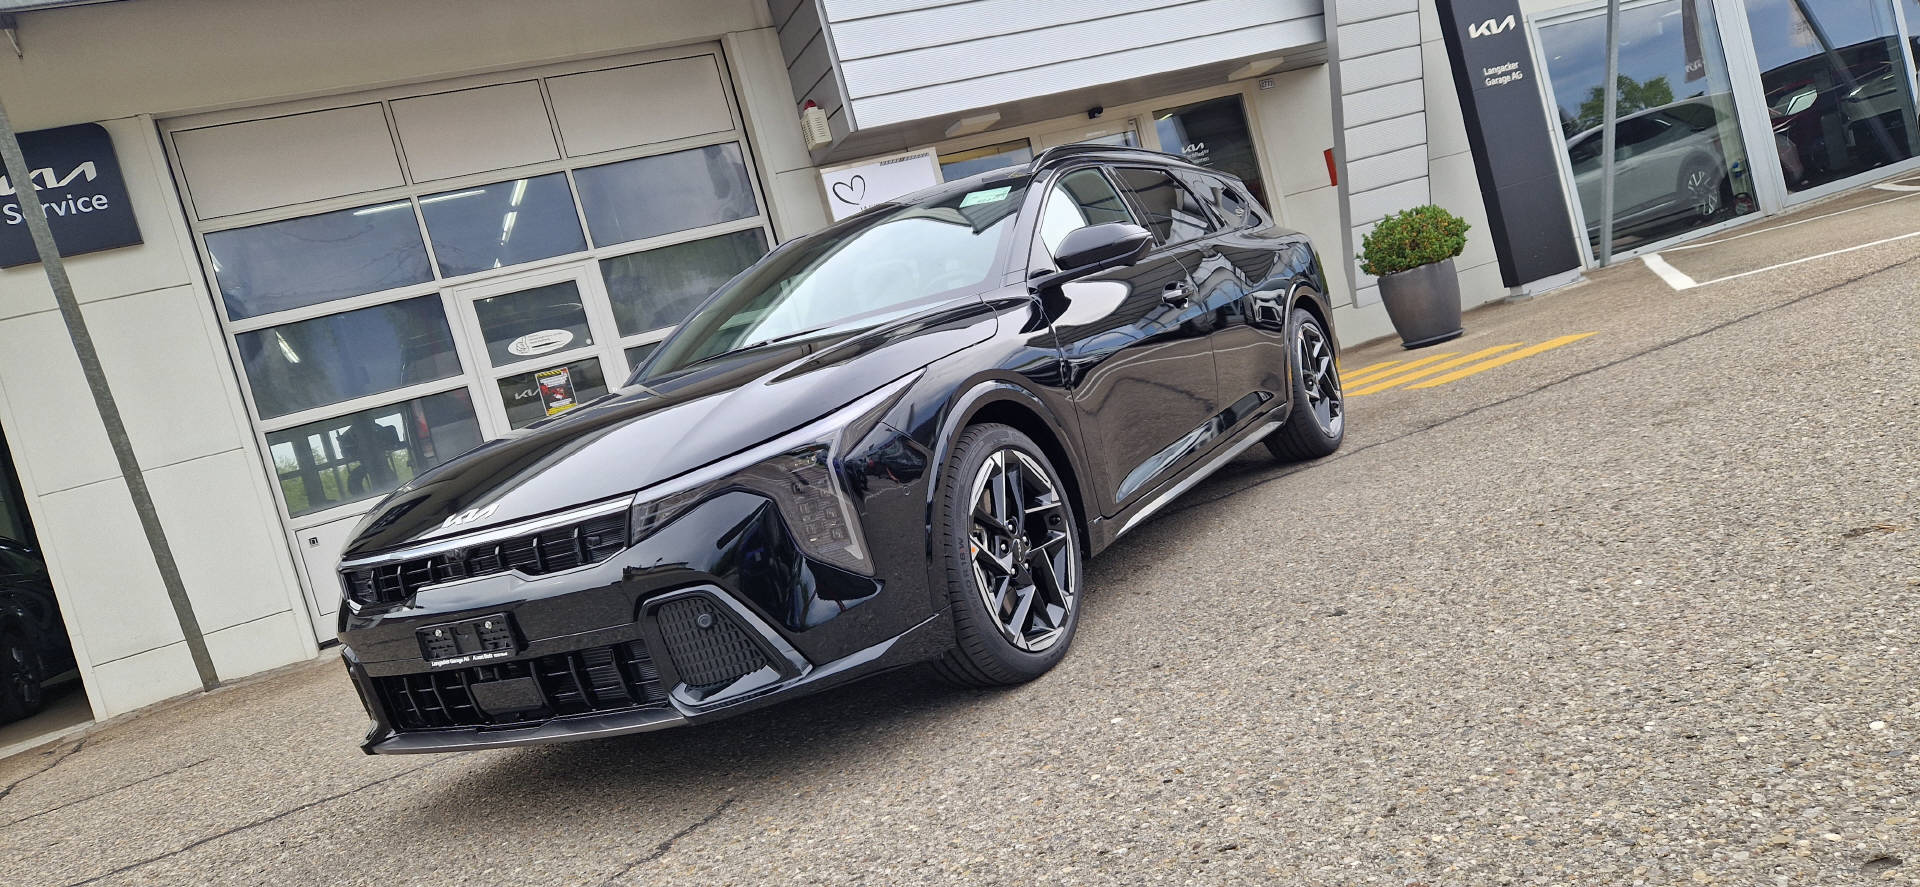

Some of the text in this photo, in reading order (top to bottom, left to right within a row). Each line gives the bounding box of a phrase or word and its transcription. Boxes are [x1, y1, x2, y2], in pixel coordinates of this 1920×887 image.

[1468, 14, 1516, 39] KIA
[1485, 70, 1523, 87] Garage AG
[2, 193, 109, 225] Srvice
[441, 503, 501, 529] KIA
